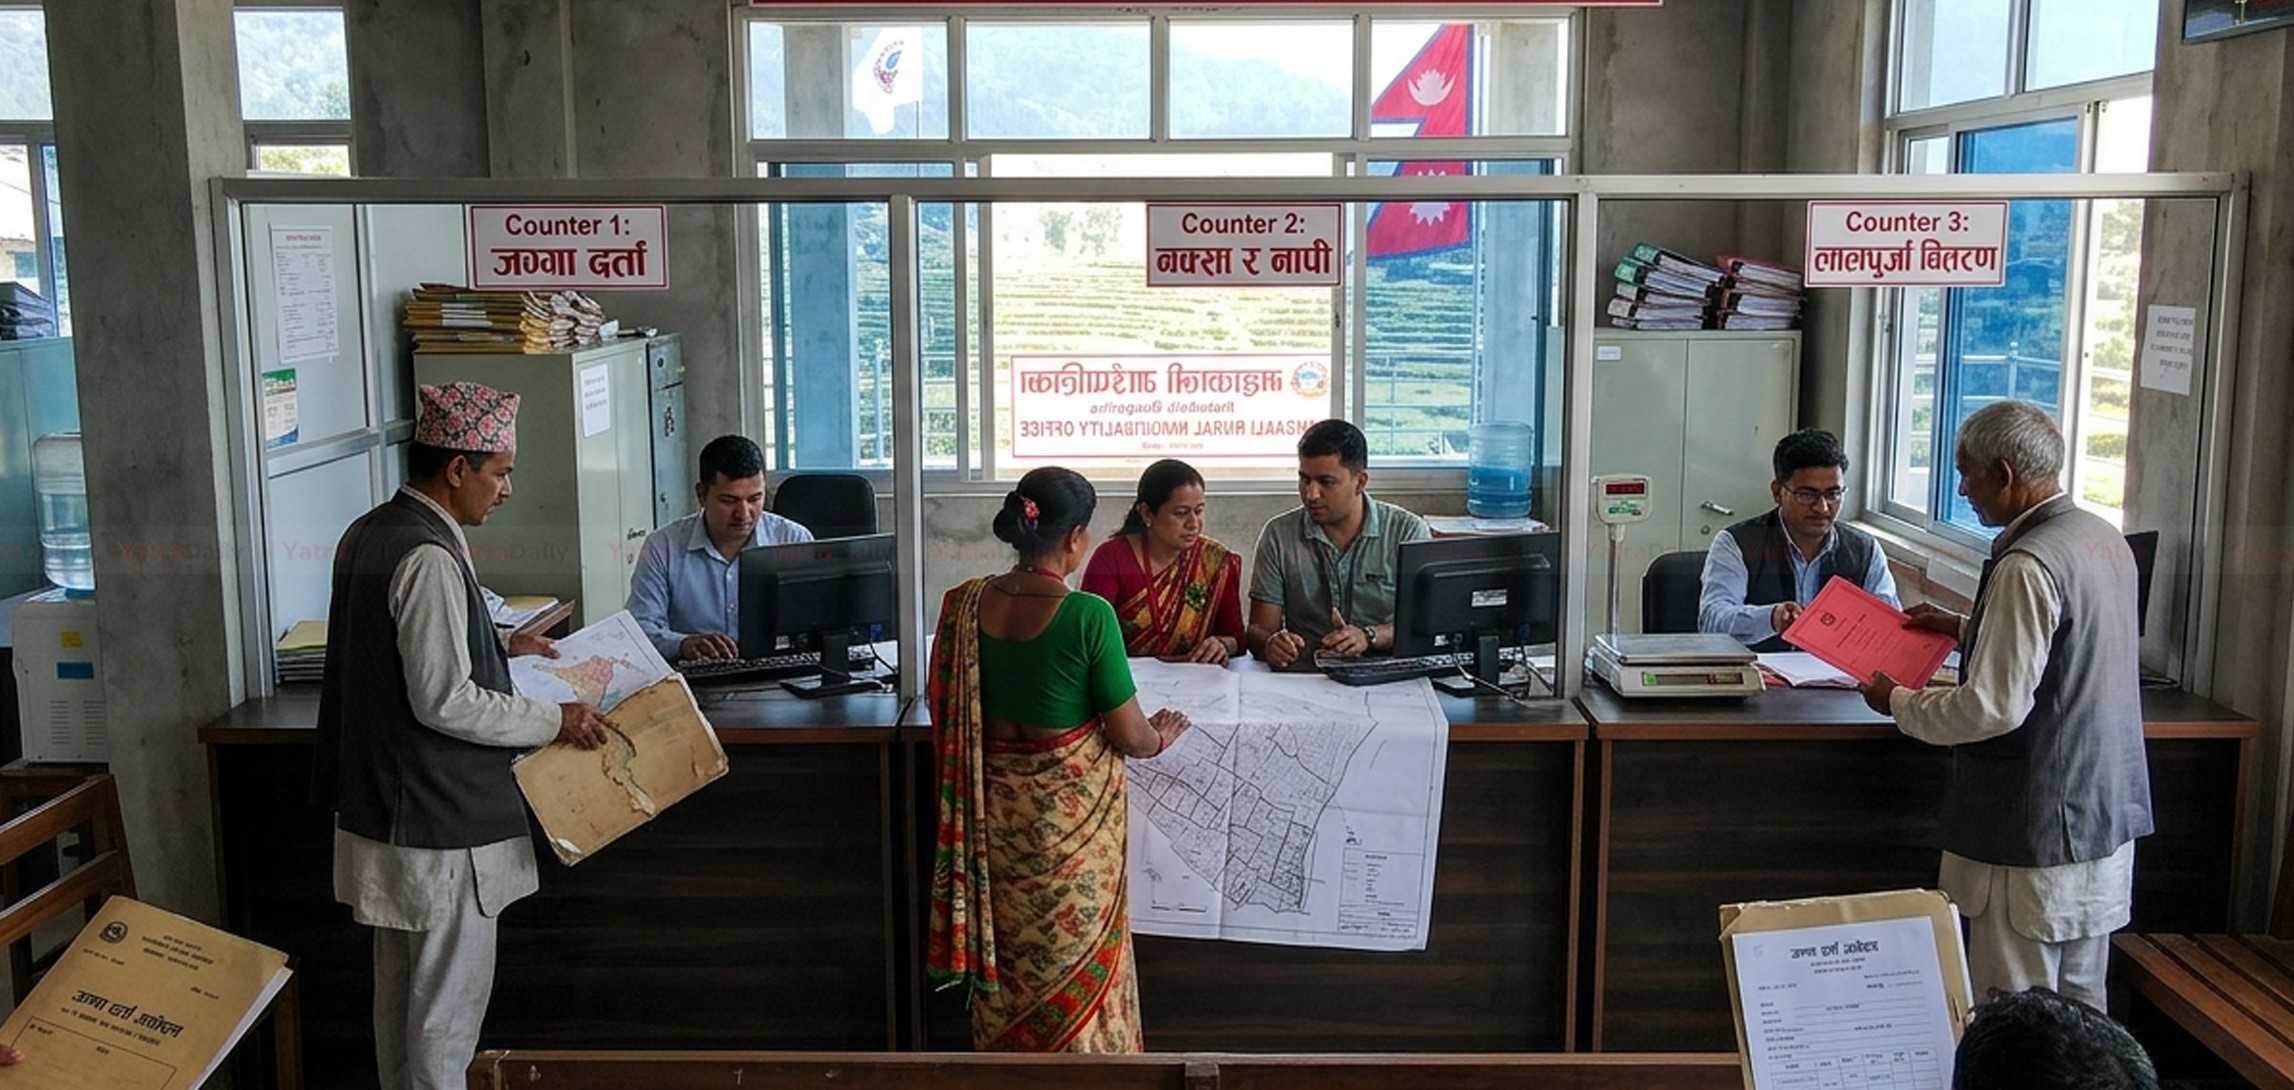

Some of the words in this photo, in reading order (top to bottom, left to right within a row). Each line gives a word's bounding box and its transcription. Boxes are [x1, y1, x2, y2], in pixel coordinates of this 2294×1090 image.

[505, 213, 602, 236] Counter
[609, 213, 631, 236] 1:
[1181, 212, 1278, 235] Counter
[1284, 212, 1306, 235] 2:
[1845, 210, 1942, 233] Counter
[1948, 210, 1970, 233] 3:
[1241, 247, 1262, 277] र
[1269, 238, 1333, 275] नापी
